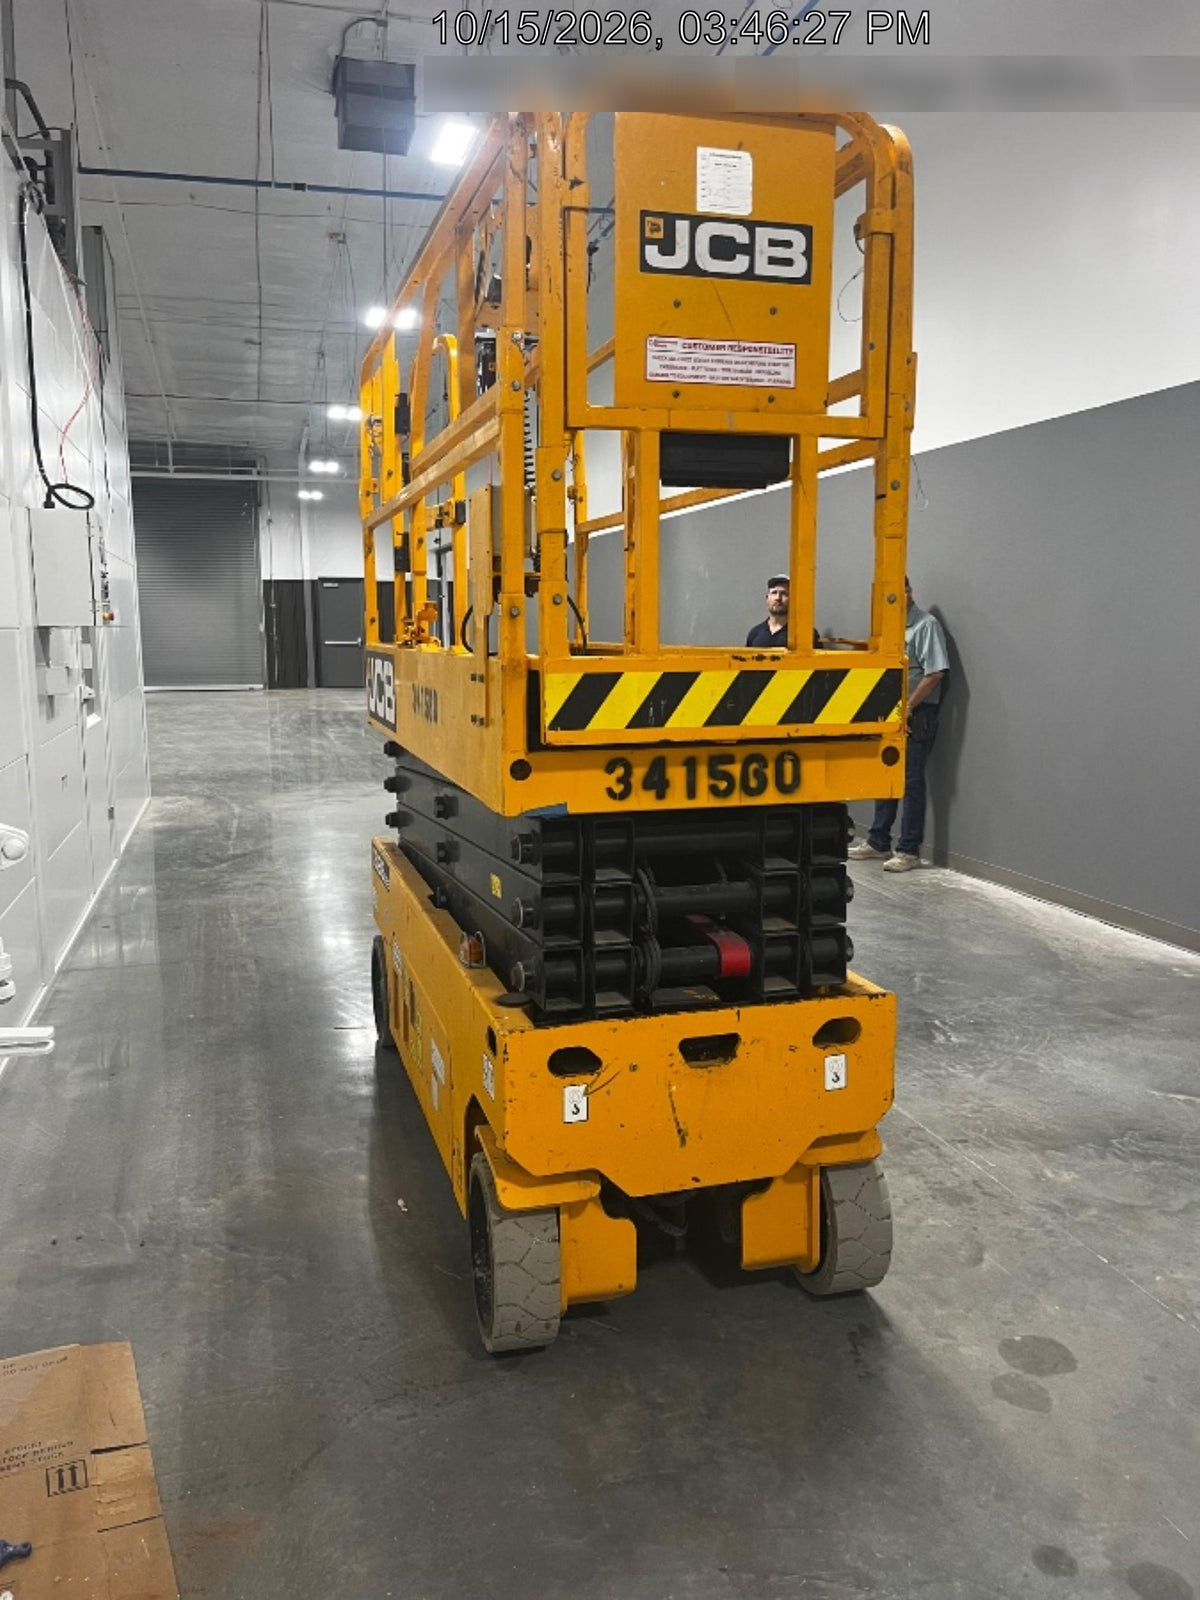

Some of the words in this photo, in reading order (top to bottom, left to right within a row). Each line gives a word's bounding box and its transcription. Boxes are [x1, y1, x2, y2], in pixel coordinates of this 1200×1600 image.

[644, 219, 808, 278] JCB
[366, 657, 396, 724] JCB
[604, 750, 801, 801] 341560
